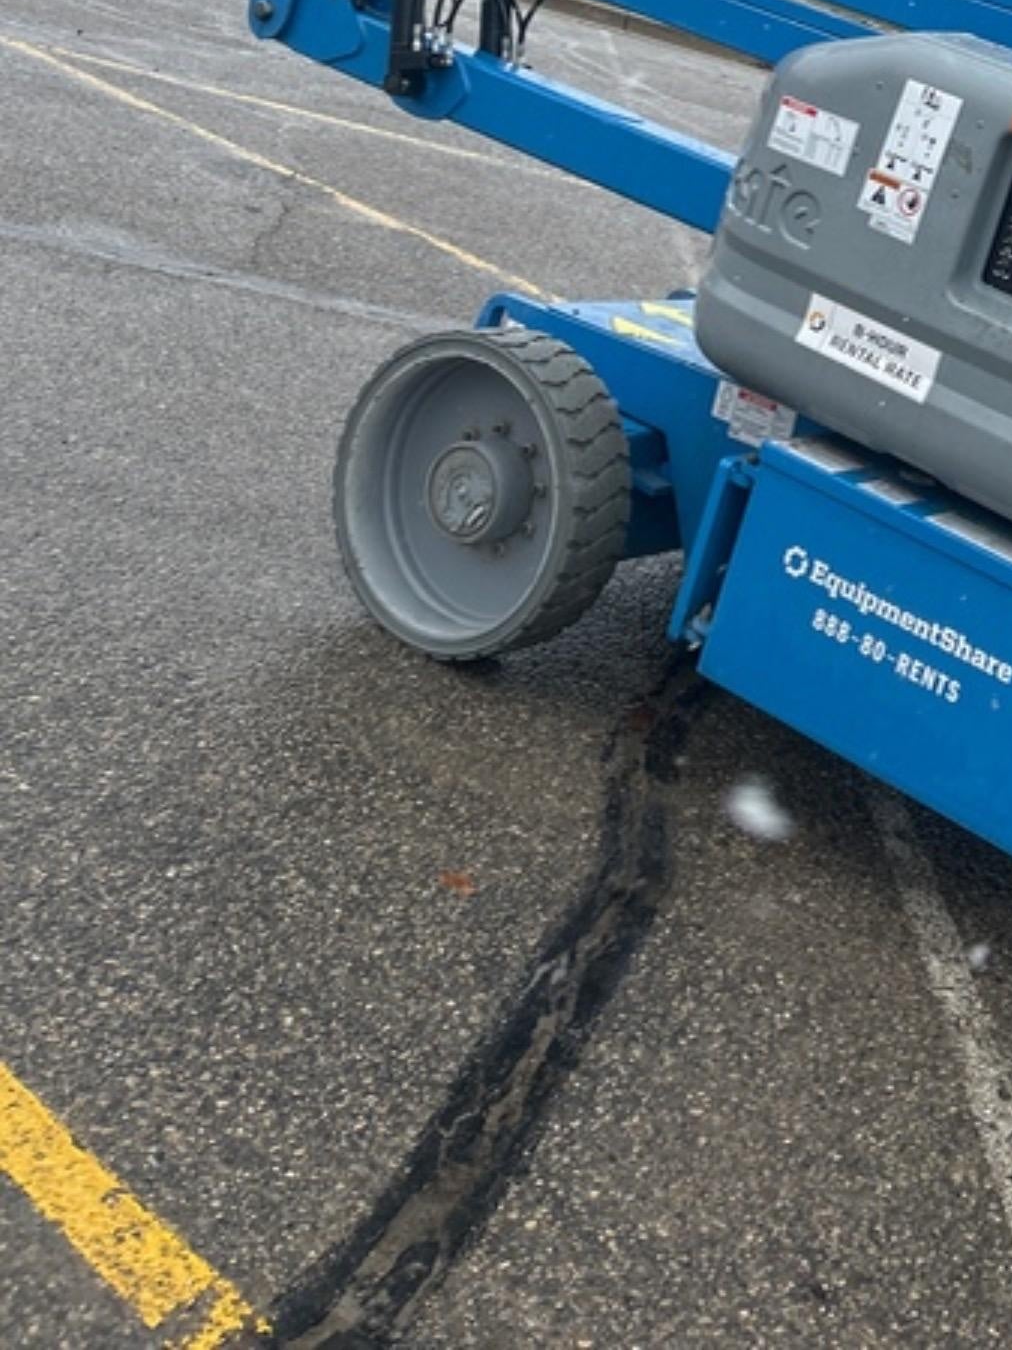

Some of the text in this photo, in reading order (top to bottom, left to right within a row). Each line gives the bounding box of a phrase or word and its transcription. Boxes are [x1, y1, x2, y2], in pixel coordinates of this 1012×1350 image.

[829, 334, 923, 390] RENTAL RATE
[811, 607, 962, 703] 888-80-RENTS
